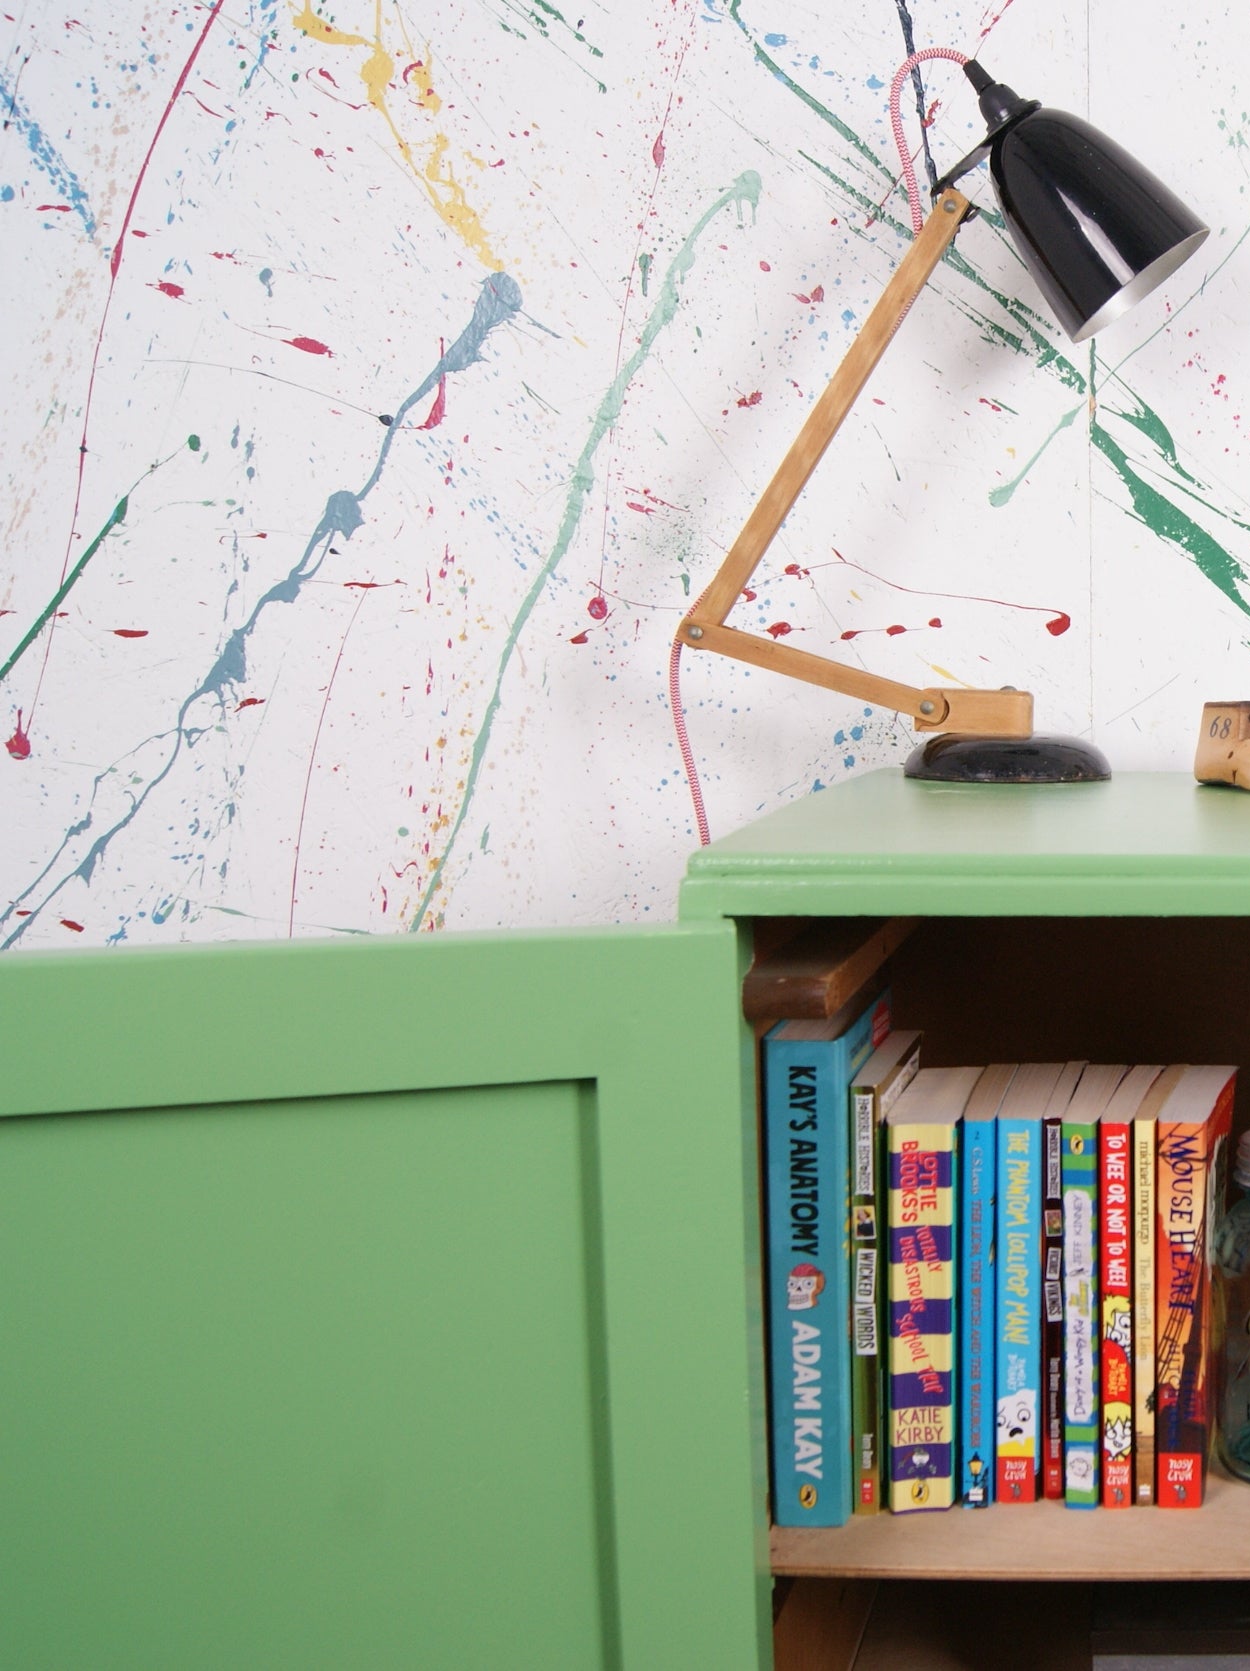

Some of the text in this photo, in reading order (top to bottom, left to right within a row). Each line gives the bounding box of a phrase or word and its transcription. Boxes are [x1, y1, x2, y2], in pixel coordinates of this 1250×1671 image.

[1208, 714, 1232, 740] 68
[788, 1065, 820, 1257] KAY'S ANATOMY
[857, 1097, 871, 1192] HORRIBLE HISTORIES
[900, 1140, 919, 1223] BROOKS'S
[918, 1151, 938, 1212] LOTTIE
[970, 1200, 982, 1224] THE
[1073, 1195, 1083, 1265] JEFF KINNEY
[1106, 1133, 1128, 1287] TO WEE OR NOT TO WEE!
[1137, 1141, 1151, 1245] michael morpurgo
[1168, 1132, 1199, 1316] MOUSE HEART
[899, 1235, 927, 1313] DISASTROUS
[915, 1225, 942, 1273] TOTALLY
[1003, 1128, 1031, 1346] THE PHANTOM LOLLIPOP MAN!
[856, 1251, 875, 1350] WICKED WORDS
[1047, 1283, 1061, 1316] VIKINGS
[1073, 1318, 1085, 1335] Kid
[1139, 1257, 1151, 1361] The Butterfly Lion
[895, 1312, 944, 1395] SCHOOL TRIP
[792, 1319, 823, 1480] ADAM KAY
[895, 1426, 944, 1445] KIRBY
[898, 1407, 943, 1426] KATIE
[1073, 1388, 1087, 1416] Diary
